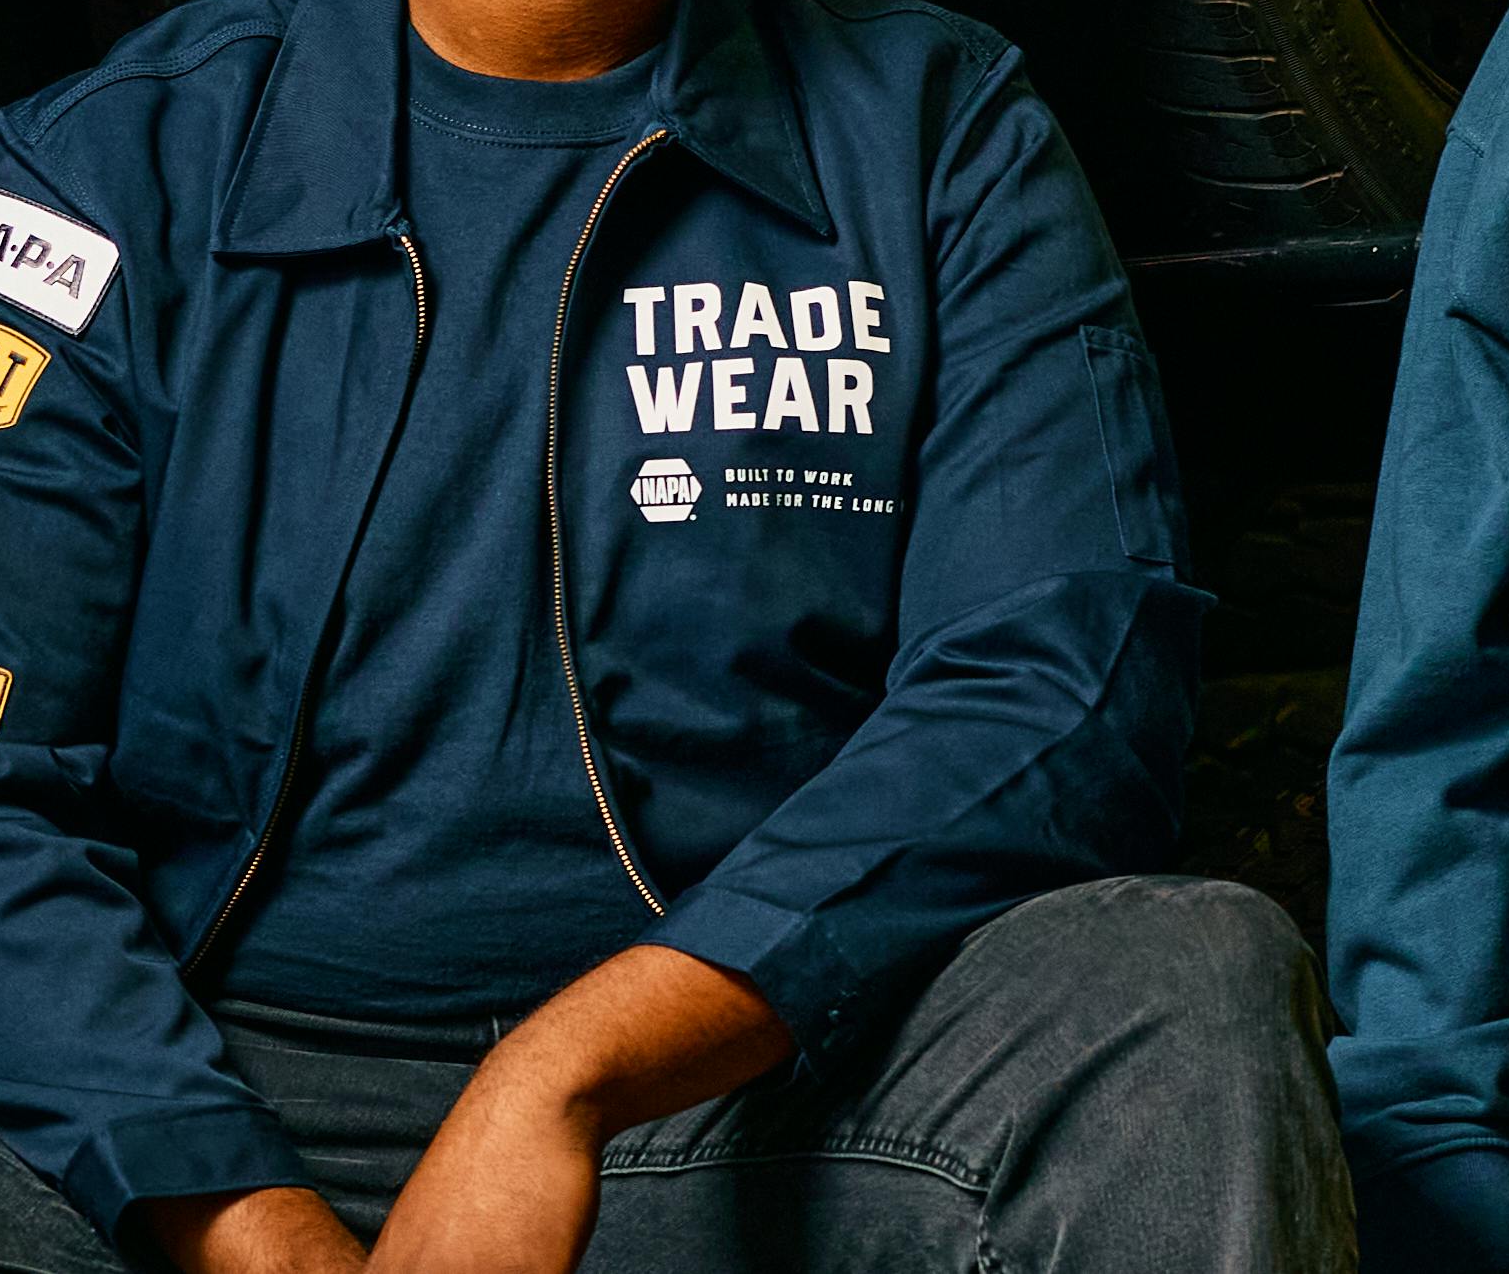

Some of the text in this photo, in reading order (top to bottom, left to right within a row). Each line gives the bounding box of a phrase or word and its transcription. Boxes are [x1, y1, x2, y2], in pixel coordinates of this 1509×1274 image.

[623, 280, 890, 355] TRADE
[626, 357, 874, 435] WEAR
[642, 476, 691, 505] NAPA
[724, 468, 853, 486] BUILT TO WORK
[726, 492, 770, 507] MADE
[776, 493, 803, 507] FOR
[811, 494, 844, 510] THE
[852, 497, 895, 513] LONG
